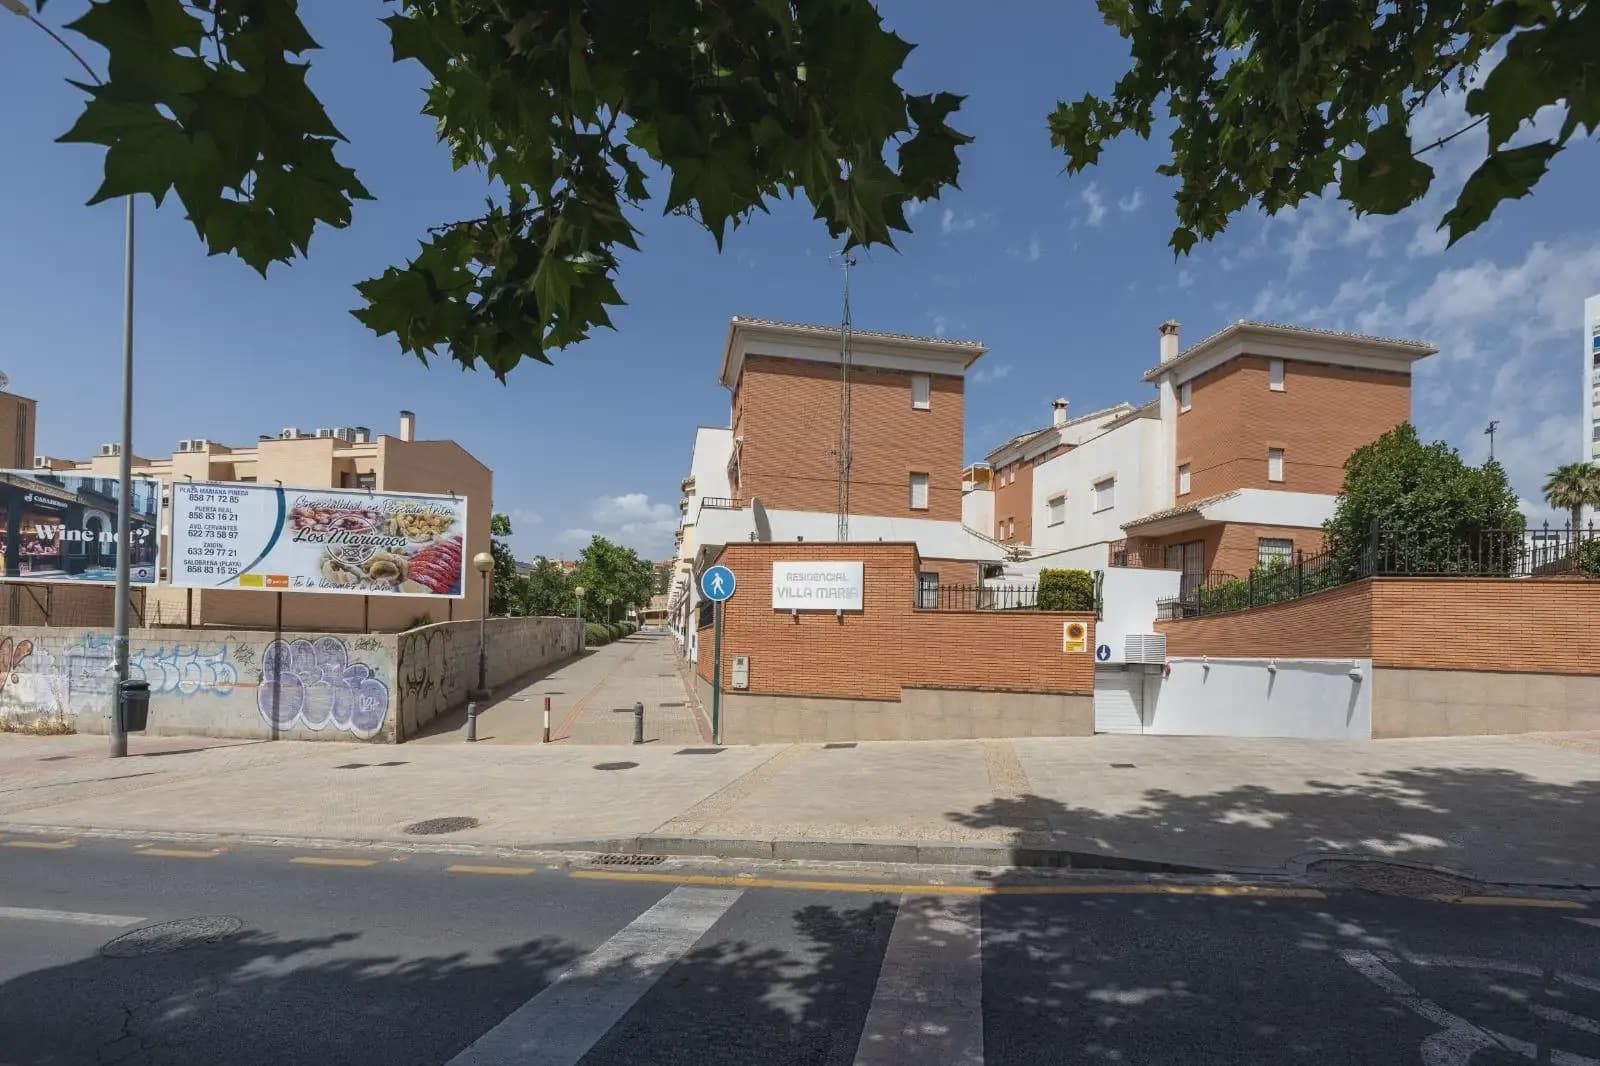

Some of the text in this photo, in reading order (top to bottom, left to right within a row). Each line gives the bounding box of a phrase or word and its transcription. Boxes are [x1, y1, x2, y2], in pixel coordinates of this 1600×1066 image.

[200, 487, 226, 495] MARIANA
[206, 494, 215, 503] 71
[218, 495, 228, 503] 72
[218, 513, 227, 521] 16
[229, 513, 238, 521] 21
[35, 524, 95, 542] Wine
[188, 529, 239, 540] 622 73 58 97
[292, 526, 407, 547] Los Marianos
[187, 547, 237, 557] 633 29 77 21
[217, 566, 226, 574] 15
[227, 567, 238, 575] 25
[786, 572, 848, 582] RESIDENCIAL
[777, 586, 813, 599] VILLA
